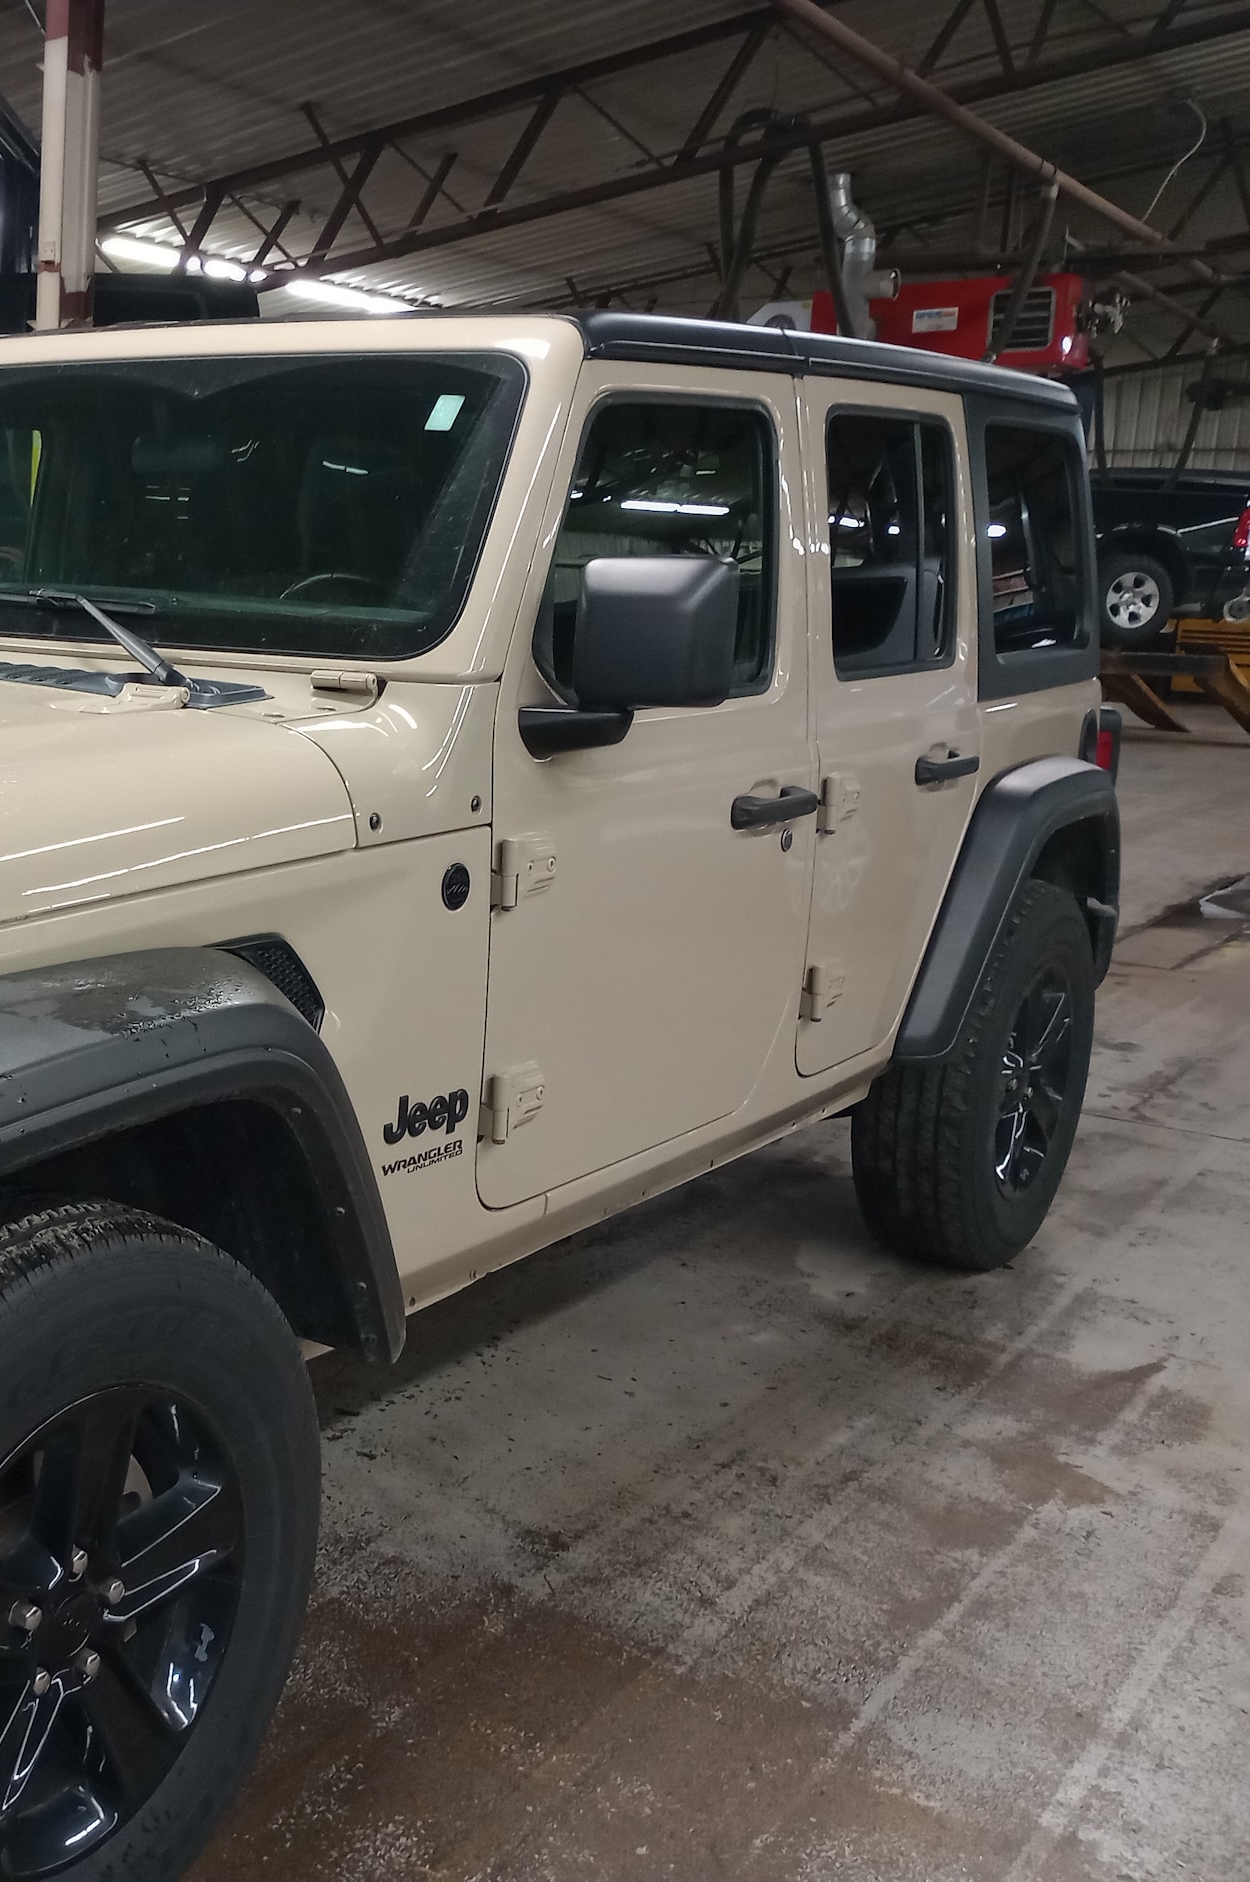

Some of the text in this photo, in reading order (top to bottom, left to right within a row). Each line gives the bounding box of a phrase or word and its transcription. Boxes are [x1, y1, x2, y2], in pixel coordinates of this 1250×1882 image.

[383, 1088, 469, 1145] Jeep
[381, 1139, 463, 1177] WRANGLER
[407, 1148, 463, 1174] UNLIMITED
